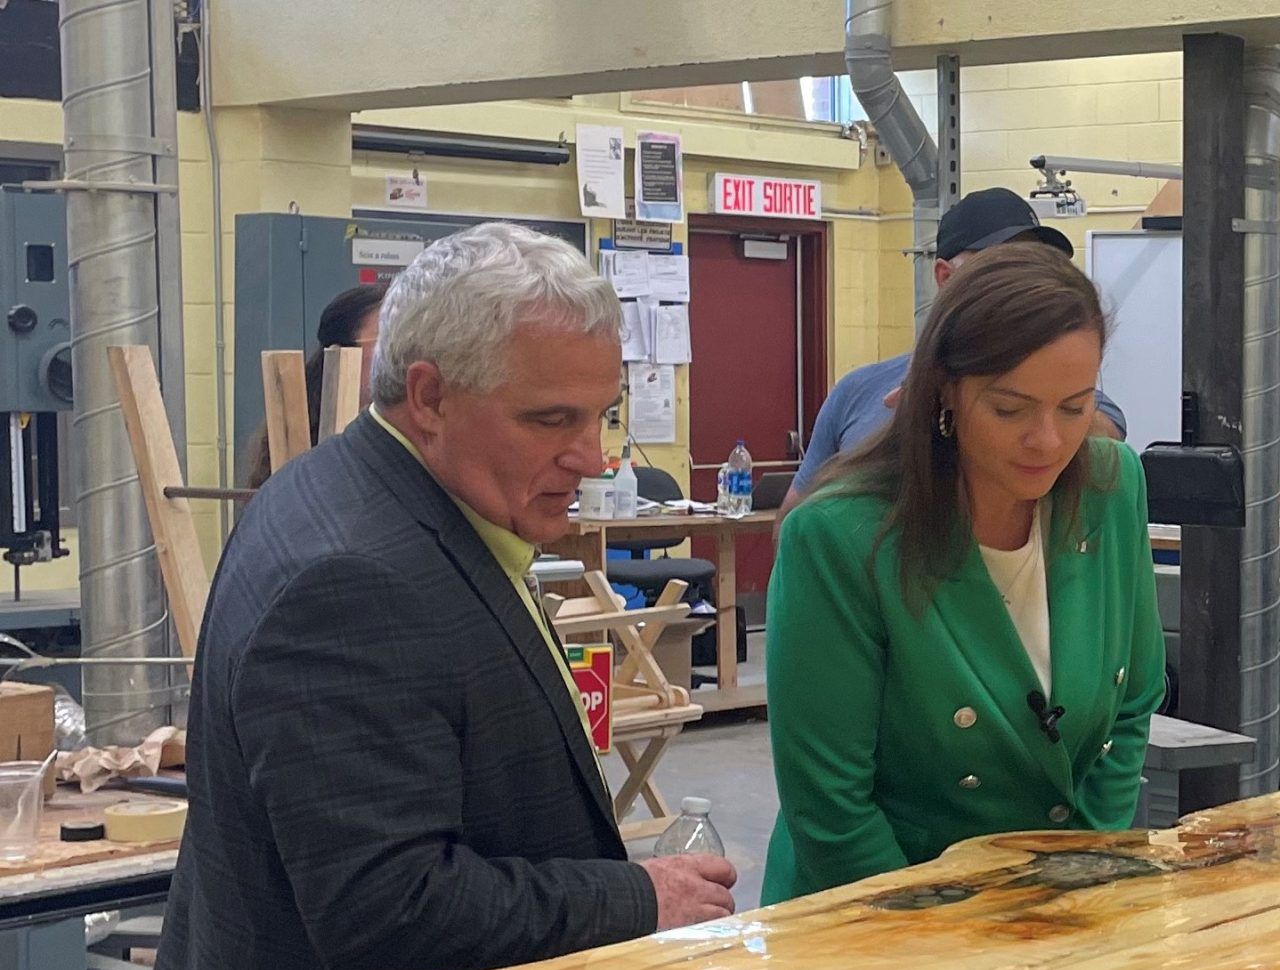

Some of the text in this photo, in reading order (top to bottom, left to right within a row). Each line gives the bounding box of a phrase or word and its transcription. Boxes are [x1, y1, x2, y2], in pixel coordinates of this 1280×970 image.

[723, 178, 816, 215] EXIT SORTIE
[580, 691, 603, 712] OP
